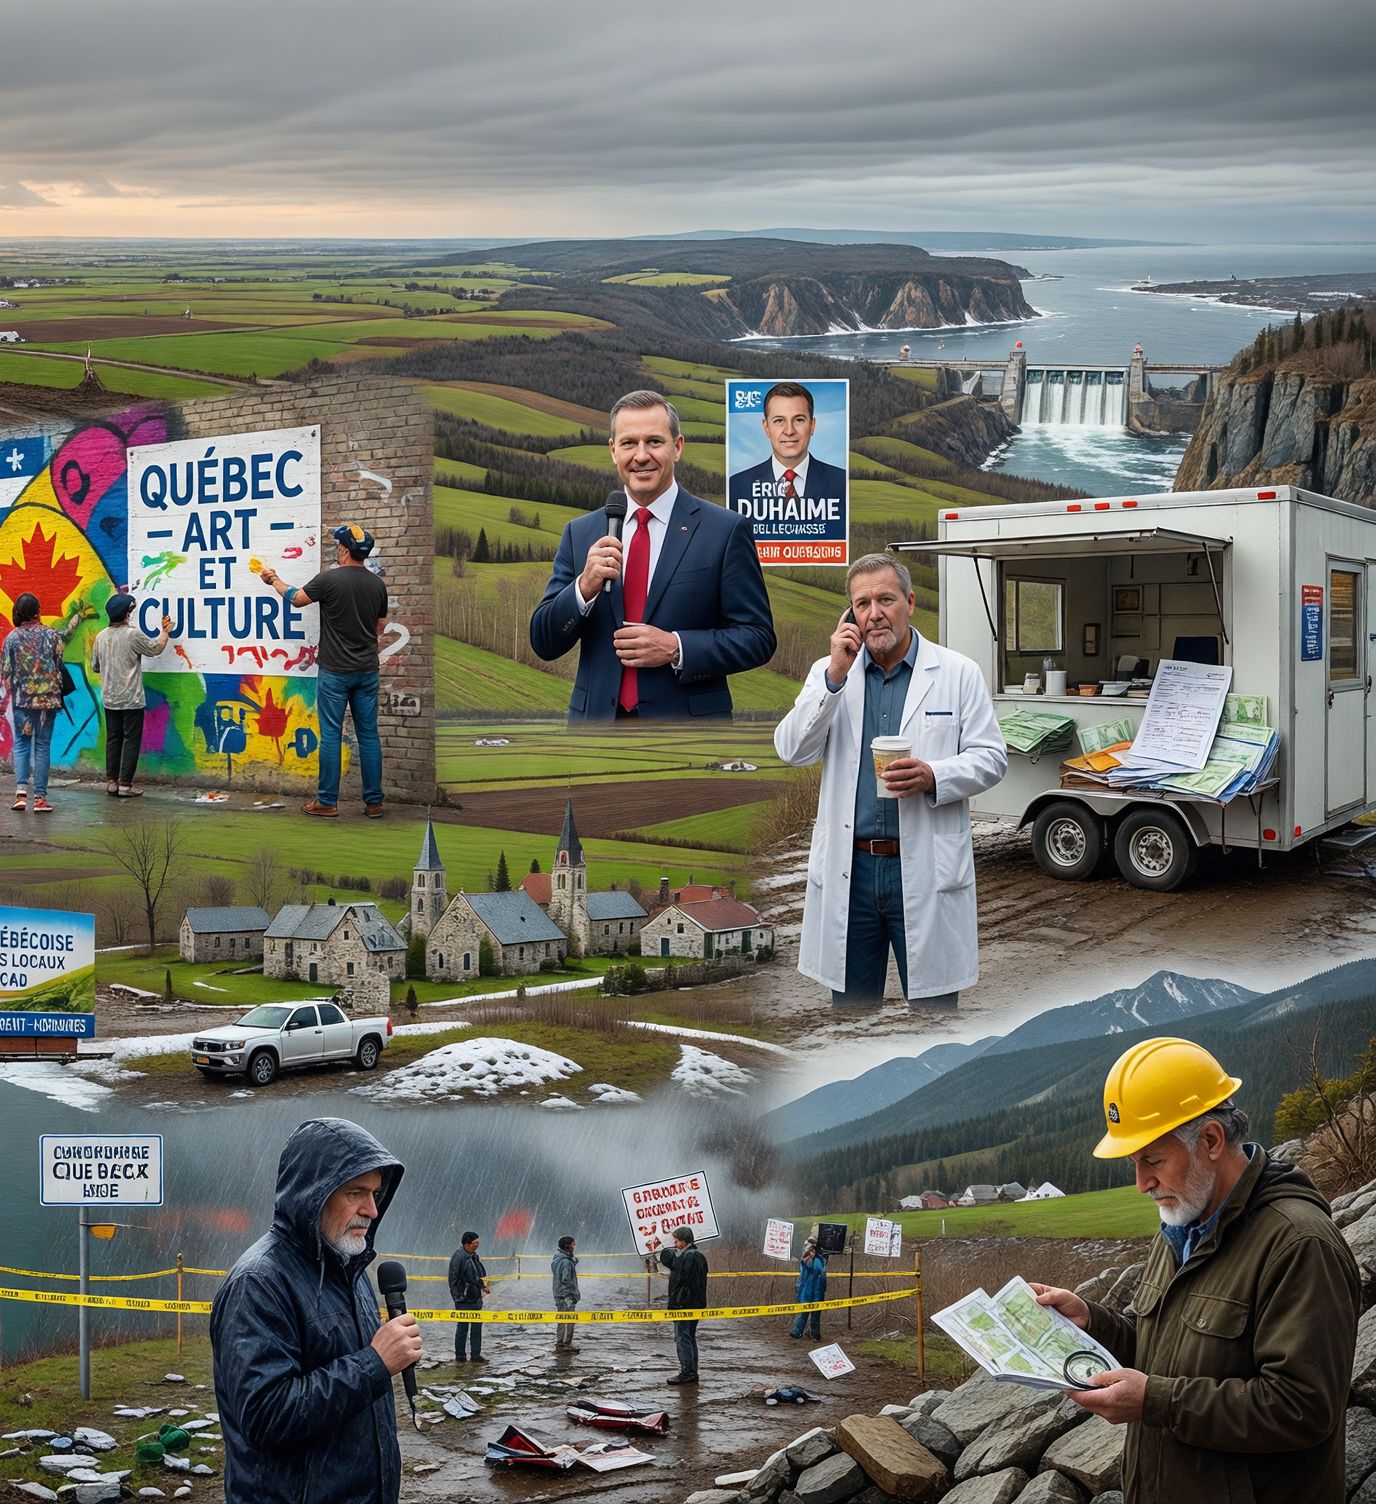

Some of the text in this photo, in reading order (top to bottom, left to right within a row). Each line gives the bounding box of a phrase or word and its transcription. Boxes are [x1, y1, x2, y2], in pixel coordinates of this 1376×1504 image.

[139, 446, 304, 510] QUÉBEC
[737, 498, 841, 521] DUHAIME
[181, 508, 257, 553] ART
[199, 555, 237, 590] ET
[139, 596, 306, 641] CULTURE
[12, 953, 66, 970] LOCAUX
